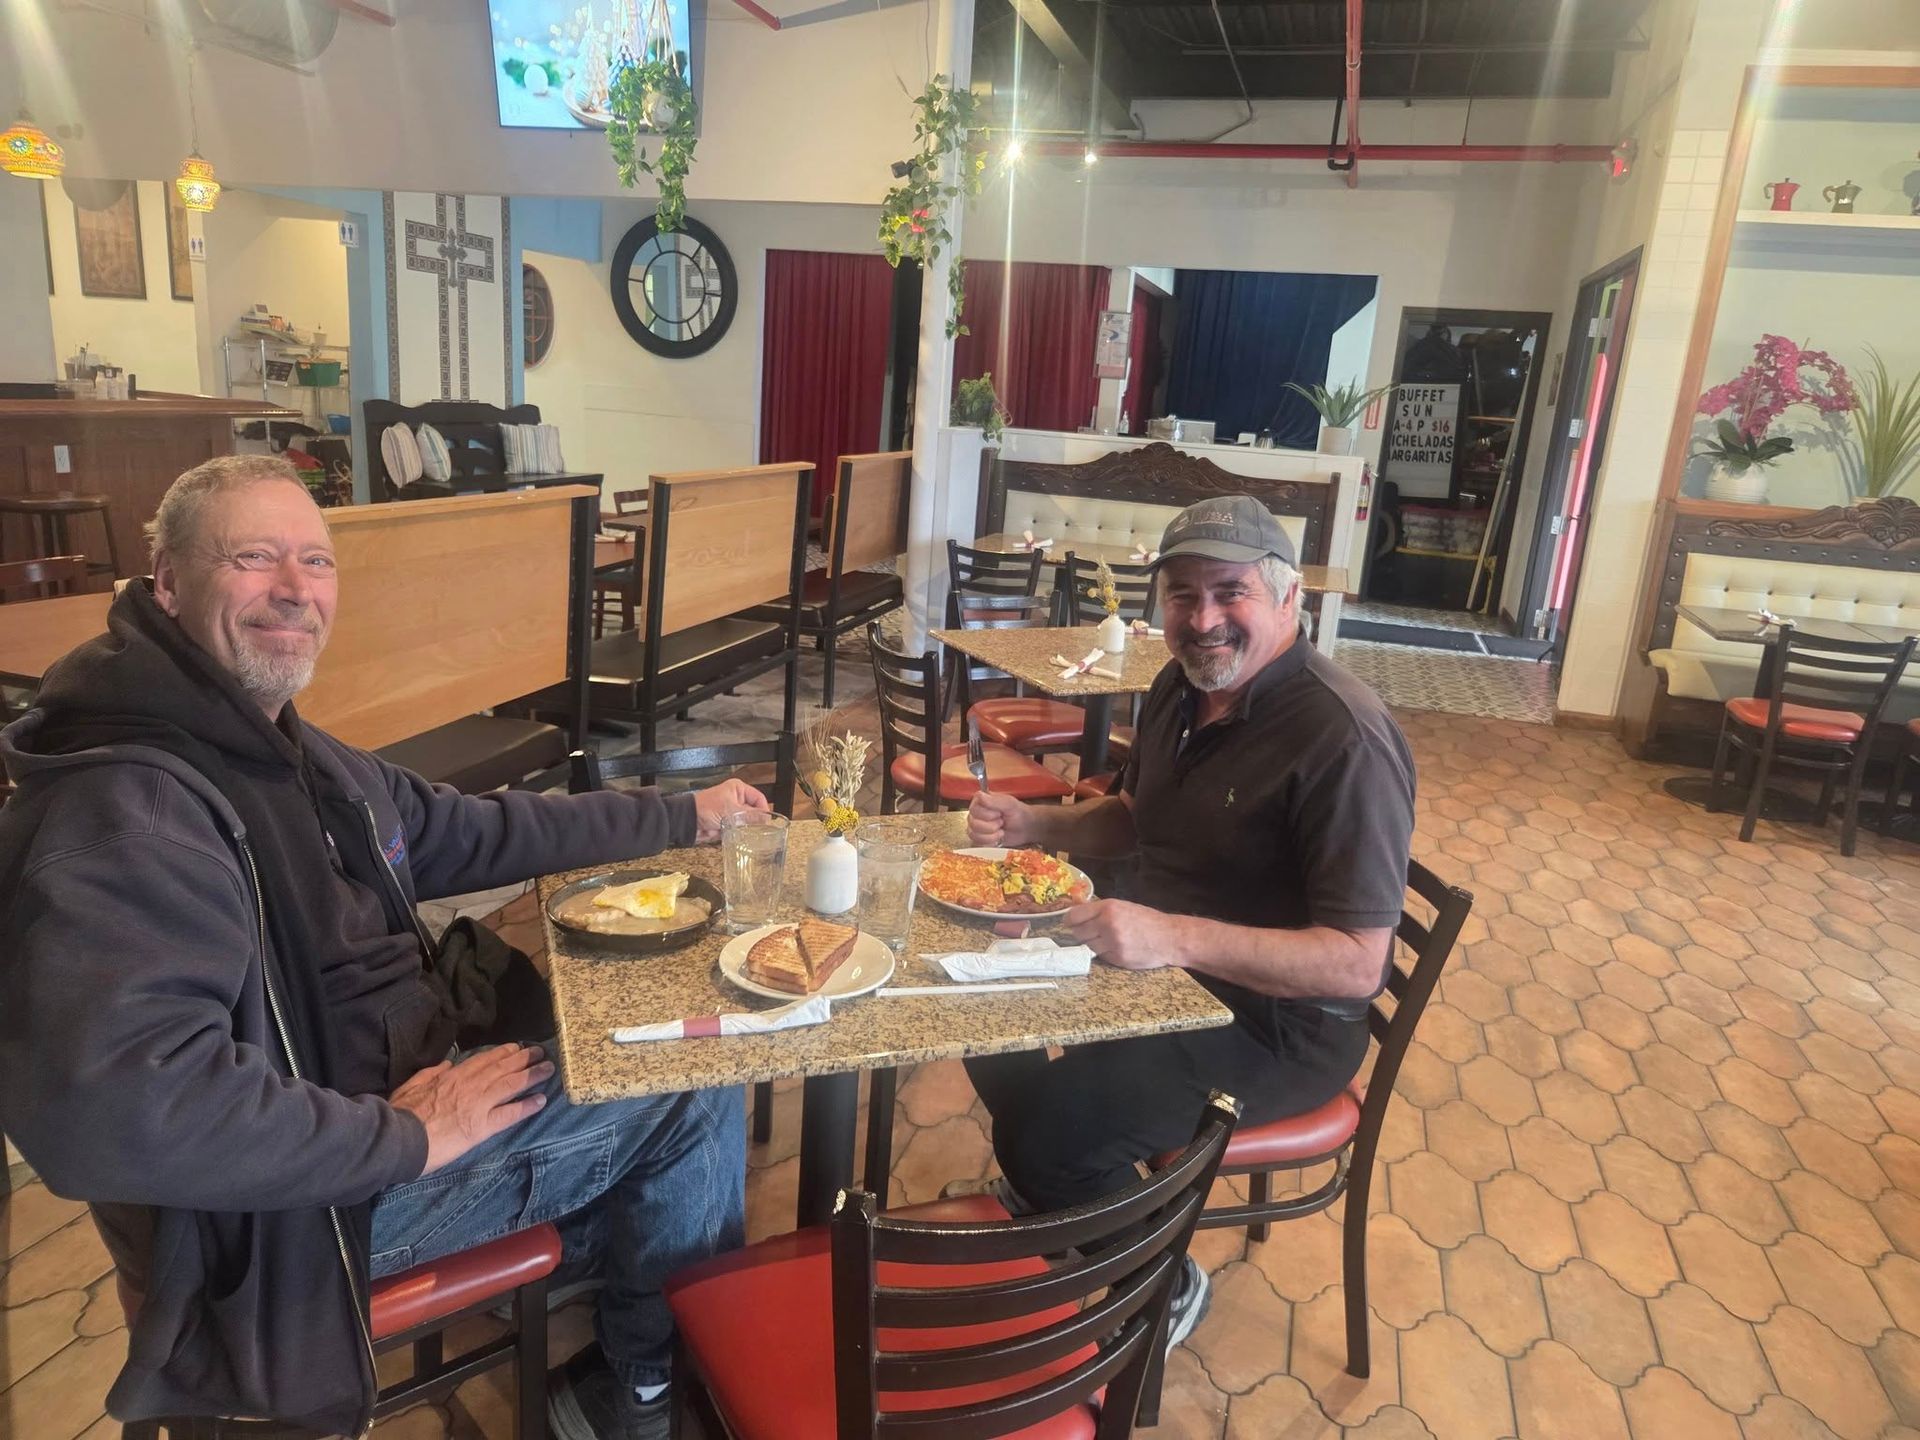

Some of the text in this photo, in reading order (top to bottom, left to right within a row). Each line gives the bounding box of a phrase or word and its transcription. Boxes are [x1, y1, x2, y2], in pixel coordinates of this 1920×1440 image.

[1399, 389, 1445, 402] BUFFET
[1431, 420, 1450, 433] $16
[1391, 434, 1453, 448] ICHELADAS
[1387, 449, 1453, 464] ARGARITAS
